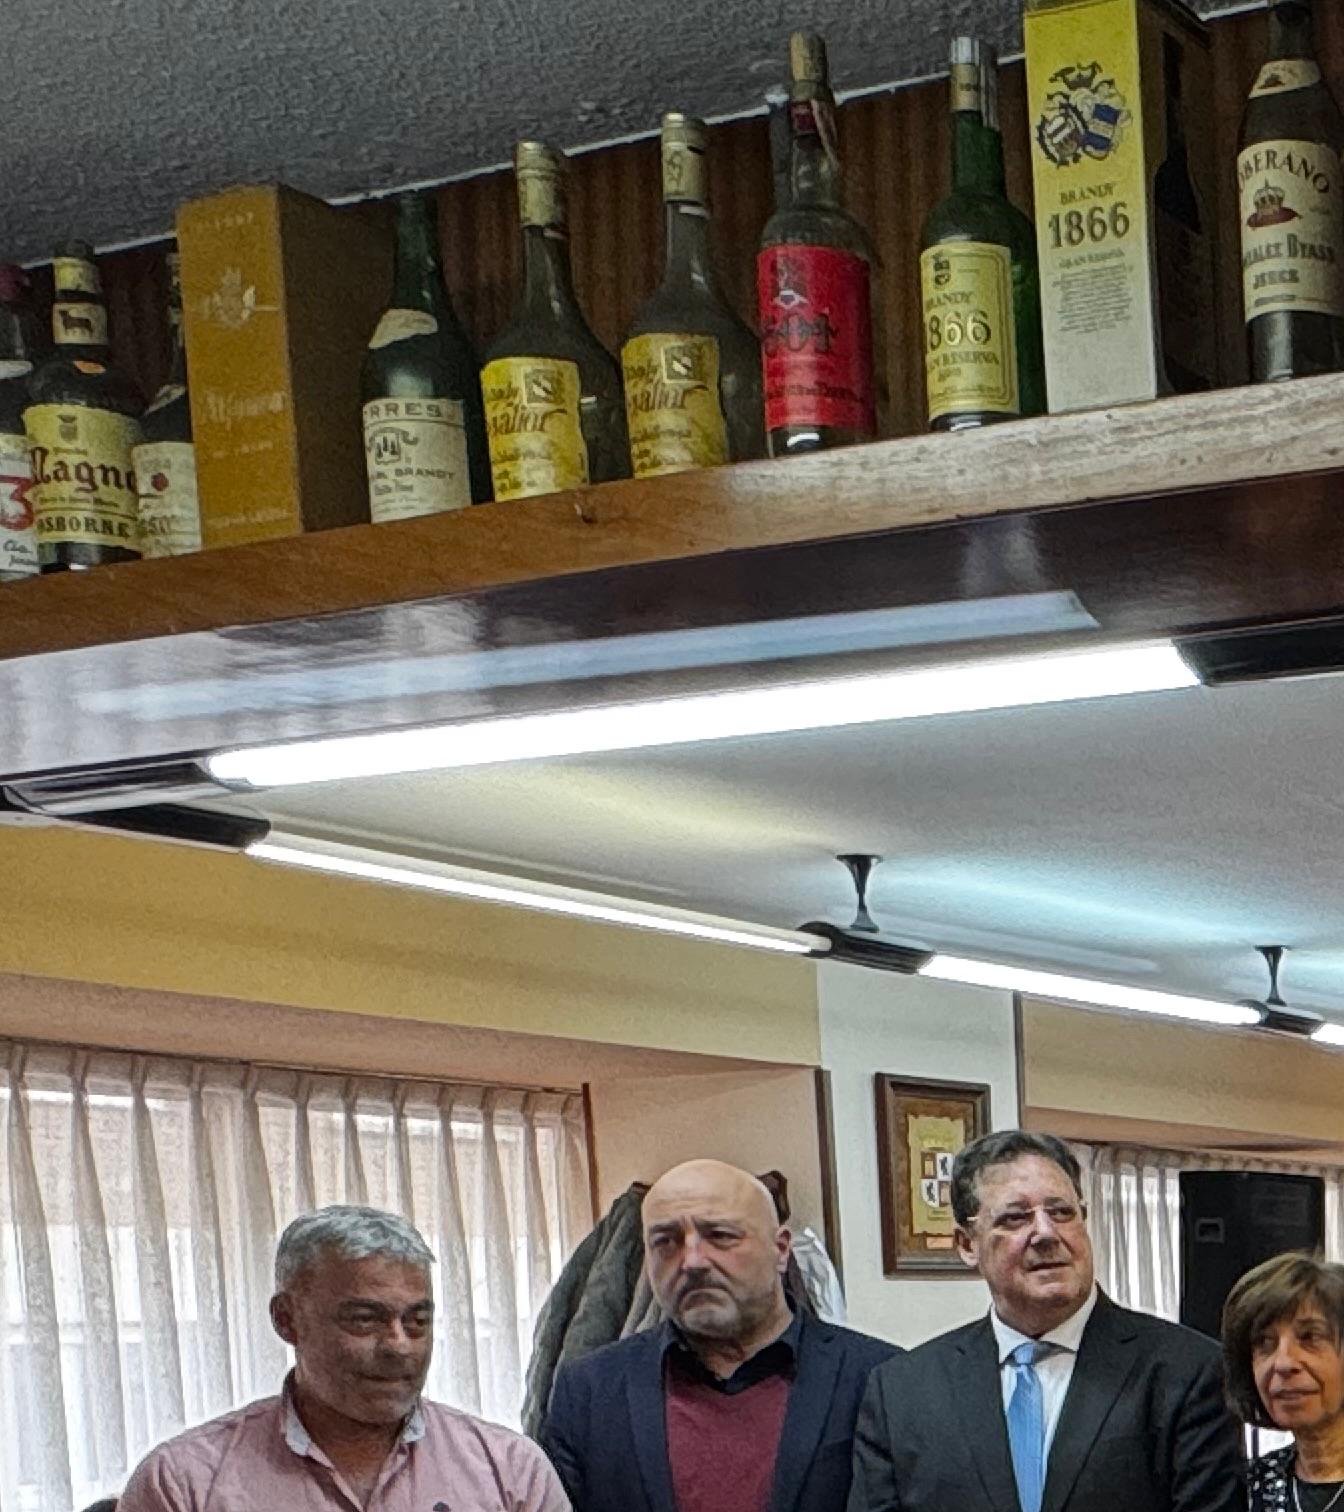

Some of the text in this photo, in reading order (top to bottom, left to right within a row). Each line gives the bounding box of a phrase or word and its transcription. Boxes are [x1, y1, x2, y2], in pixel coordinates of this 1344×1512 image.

[1060, 183, 1117, 205] BRANDY
[1048, 200, 1131, 248] 1866
[928, 310, 992, 351] 866
